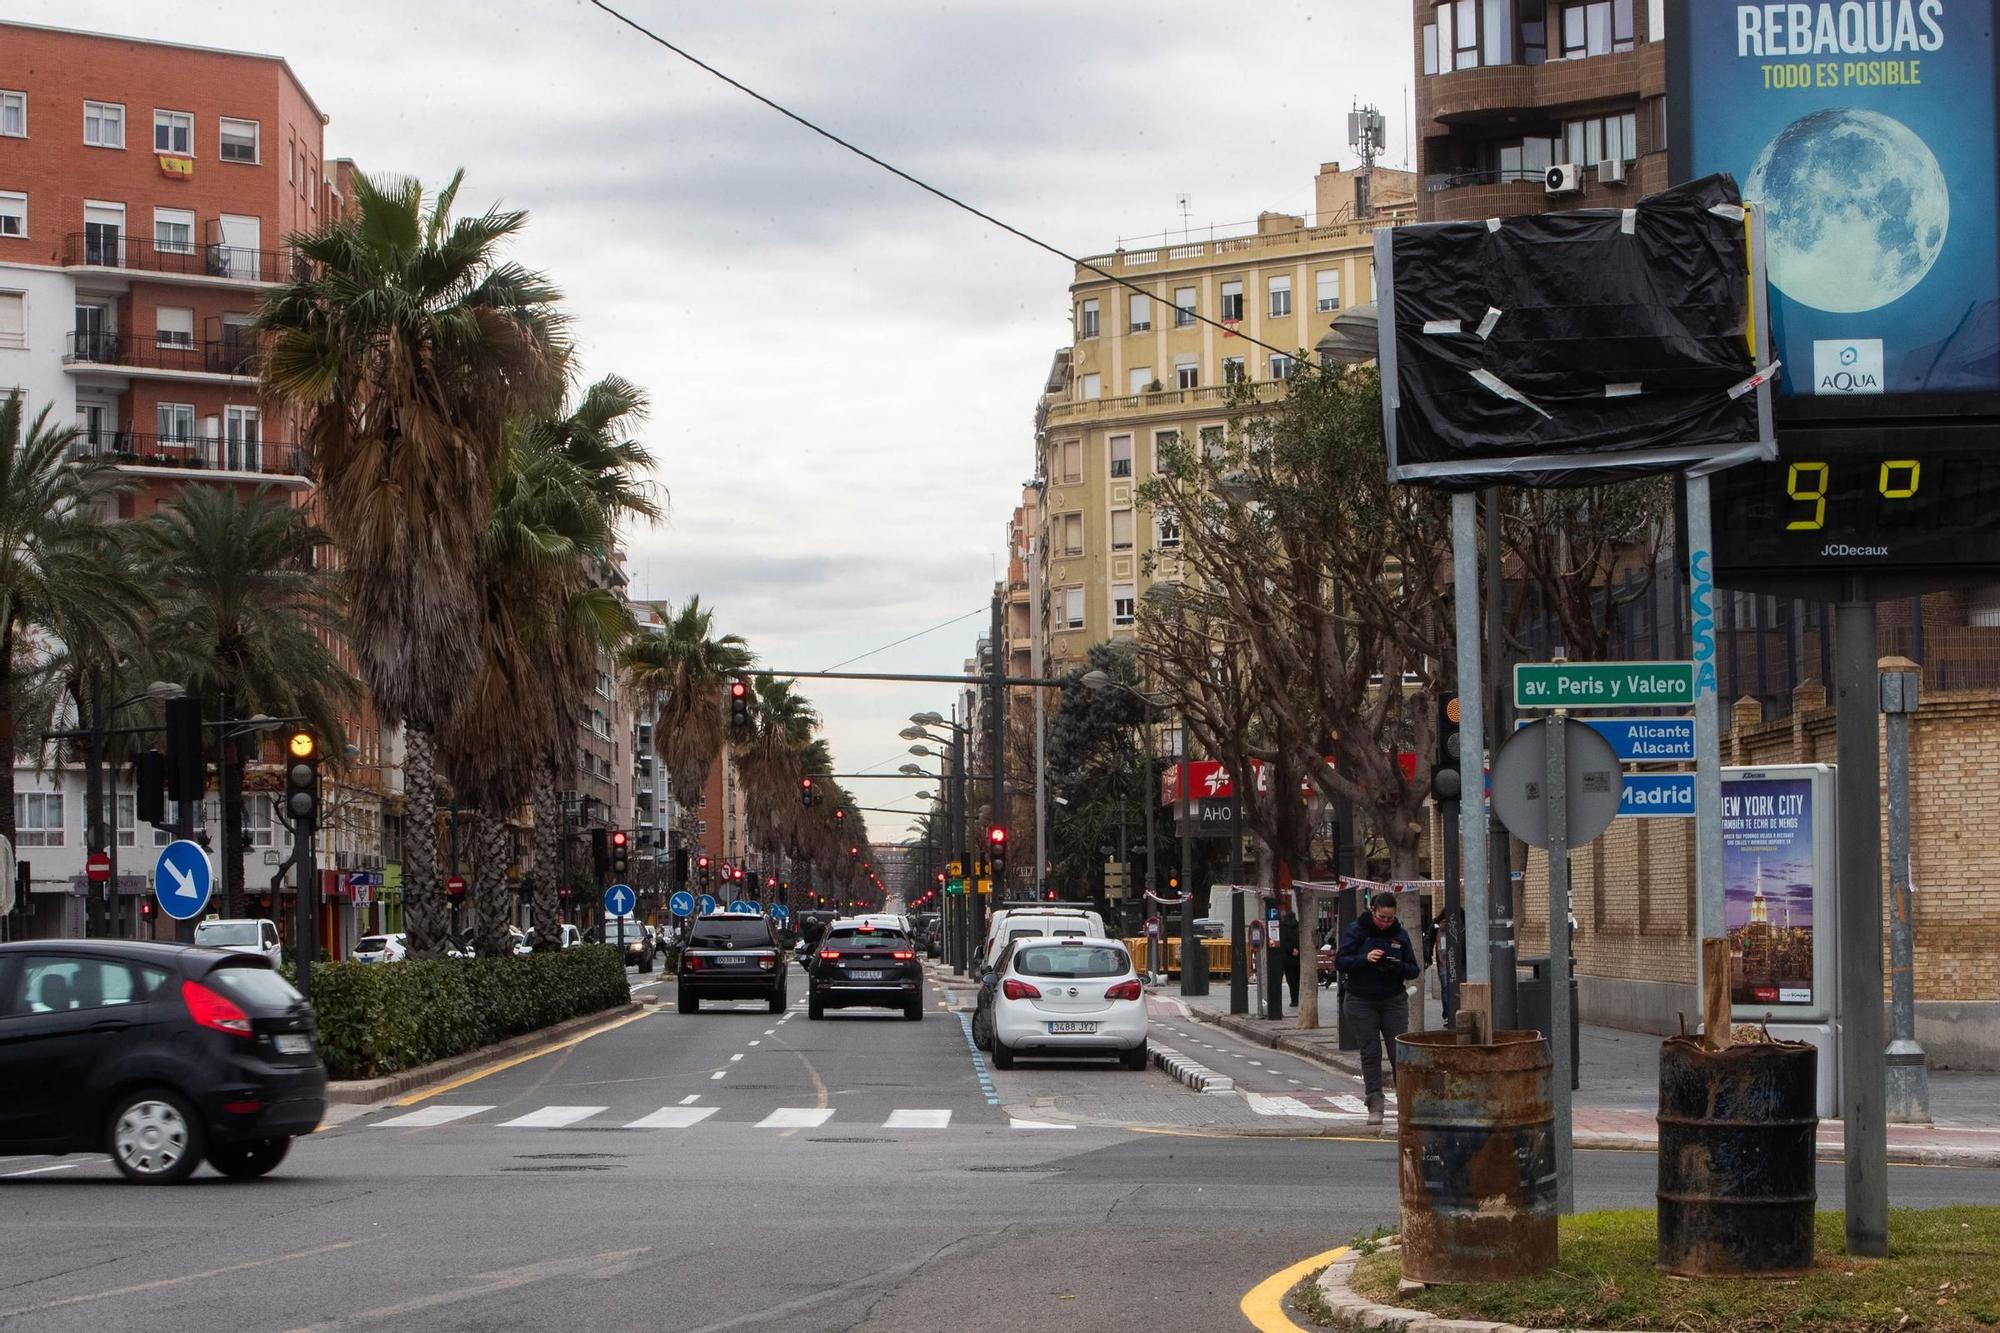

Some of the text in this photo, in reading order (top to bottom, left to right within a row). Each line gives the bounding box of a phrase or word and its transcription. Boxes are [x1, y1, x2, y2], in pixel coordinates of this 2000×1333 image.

[1737, 0, 1944, 57] REBAQUAS
[1761, 60, 1921, 89] TODO ES POSIBLE
[1821, 371, 1877, 391] AQUA
[1821, 544, 1888, 556] JCDecaux
[1525, 675, 1687, 698] av. Peris y Valero
[1628, 725, 1690, 738] Alicante
[1632, 741, 1690, 754] Alacant
[1744, 795, 1774, 816] YORK
[1778, 794, 1804, 815] CITY
[1745, 819, 1752, 829] TE
[1753, 818, 1769, 829] ECHA
[1769, 818, 1777, 828] DE
[1778, 817, 1798, 828] MENOS
[1054, 1023, 1076, 1031] 3488
